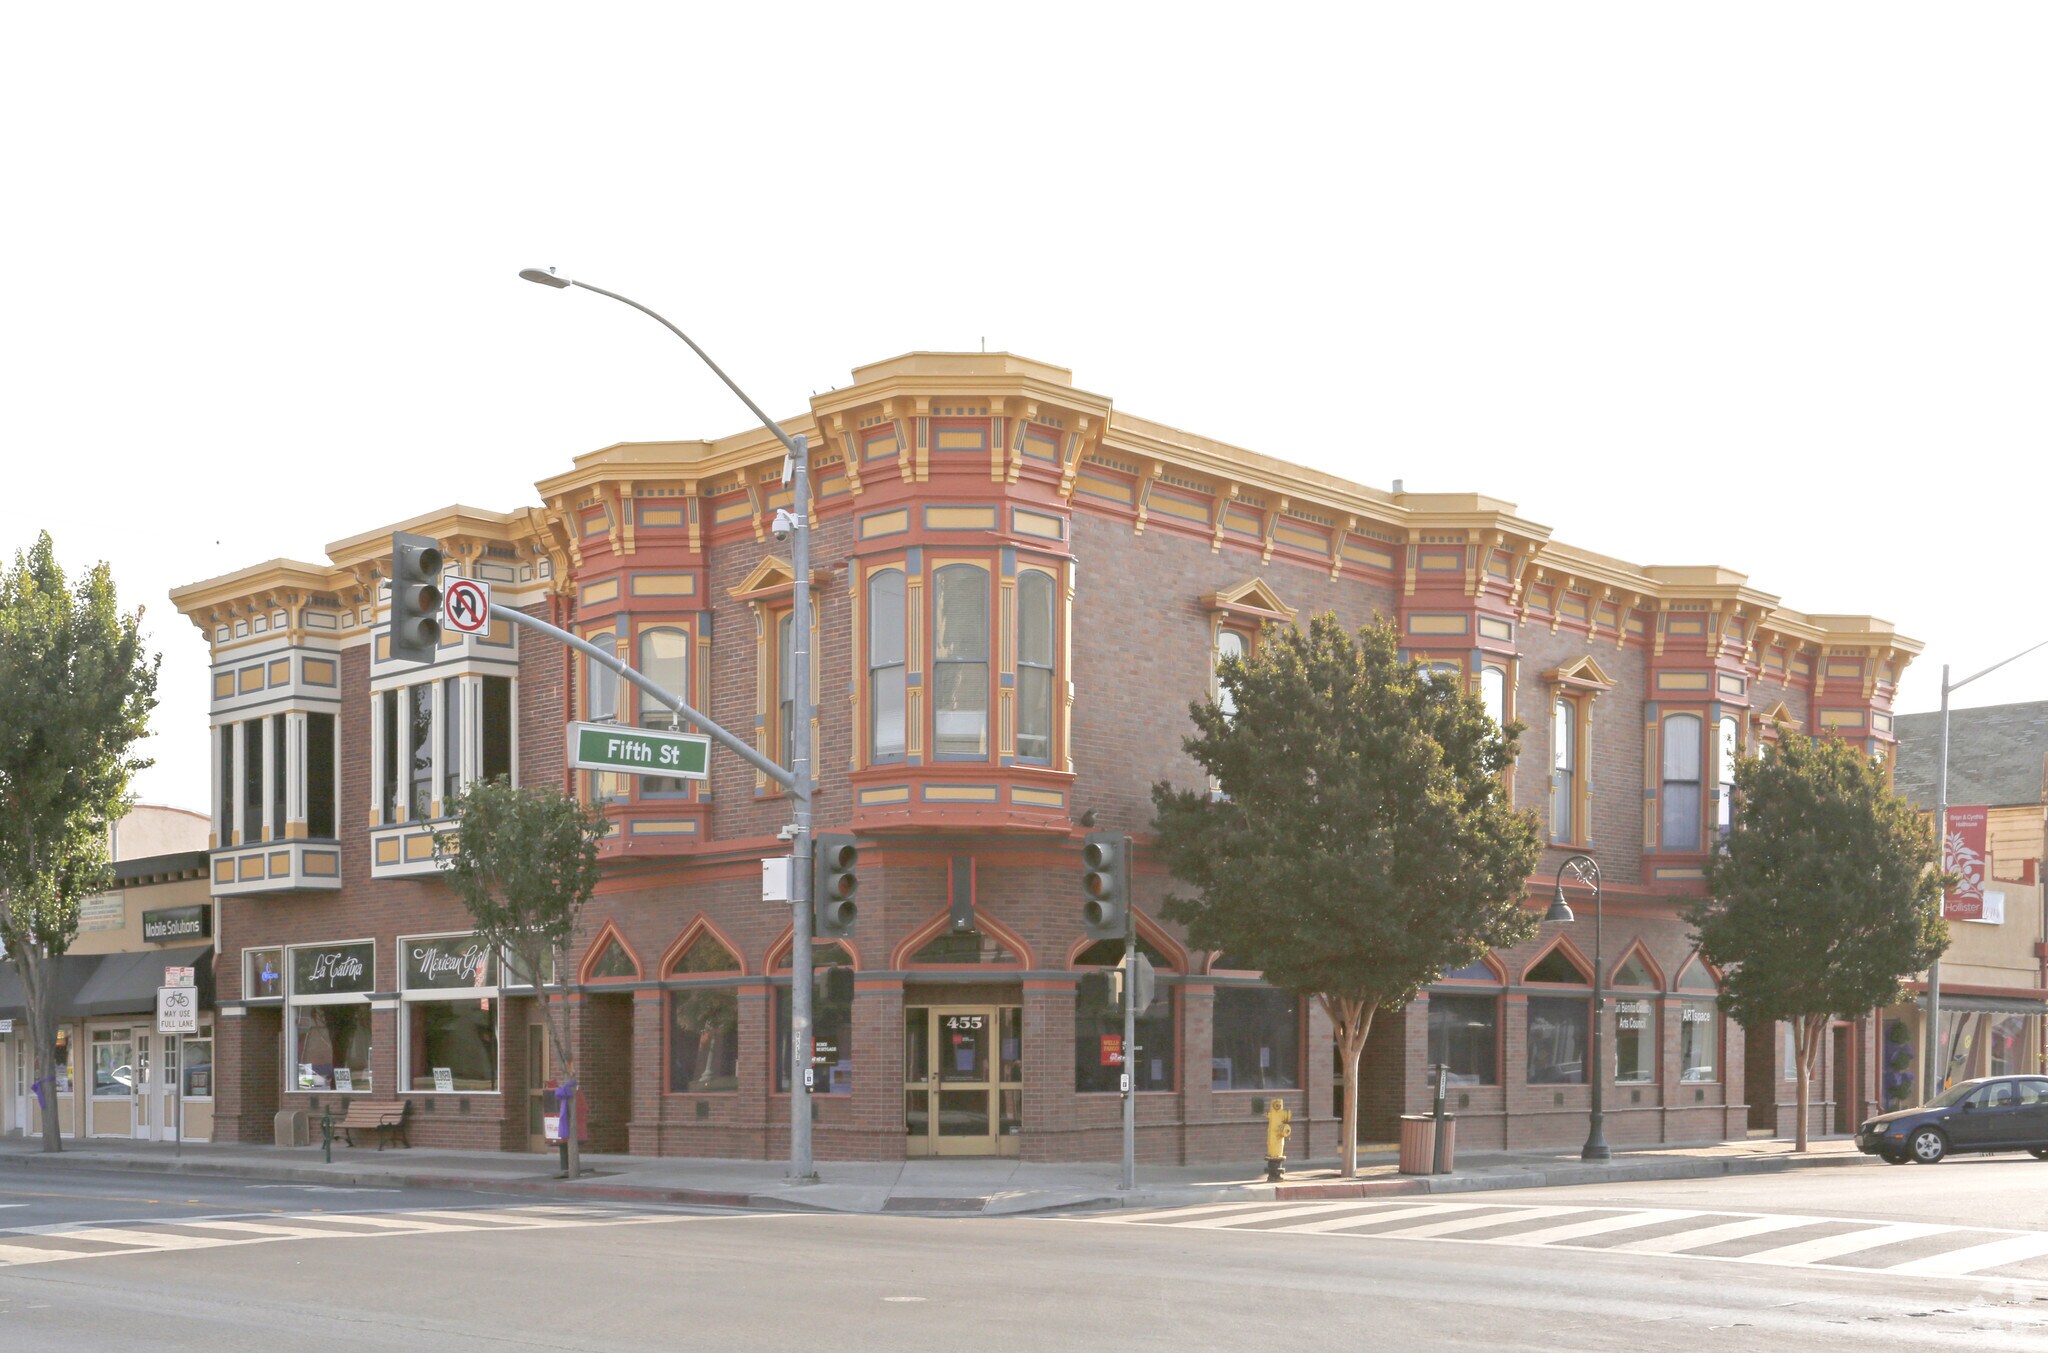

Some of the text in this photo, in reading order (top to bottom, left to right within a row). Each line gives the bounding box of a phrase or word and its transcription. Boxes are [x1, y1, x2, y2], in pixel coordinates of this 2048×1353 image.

[607, 738, 680, 765] Fifth St
[1945, 902, 1981, 913] Hollister
[145, 919, 200, 938] Mobile Solutions
[413, 944, 491, 981] Mexican Grill
[308, 953, 363, 989] La Catrina
[164, 1009, 191, 1018] MAY USE
[1682, 1009, 1711, 1024] ARTspace
[161, 1020, 194, 1028] FULL LANE
[946, 1016, 983, 1029] 455
[1619, 1018, 1646, 1029] Arts Council
